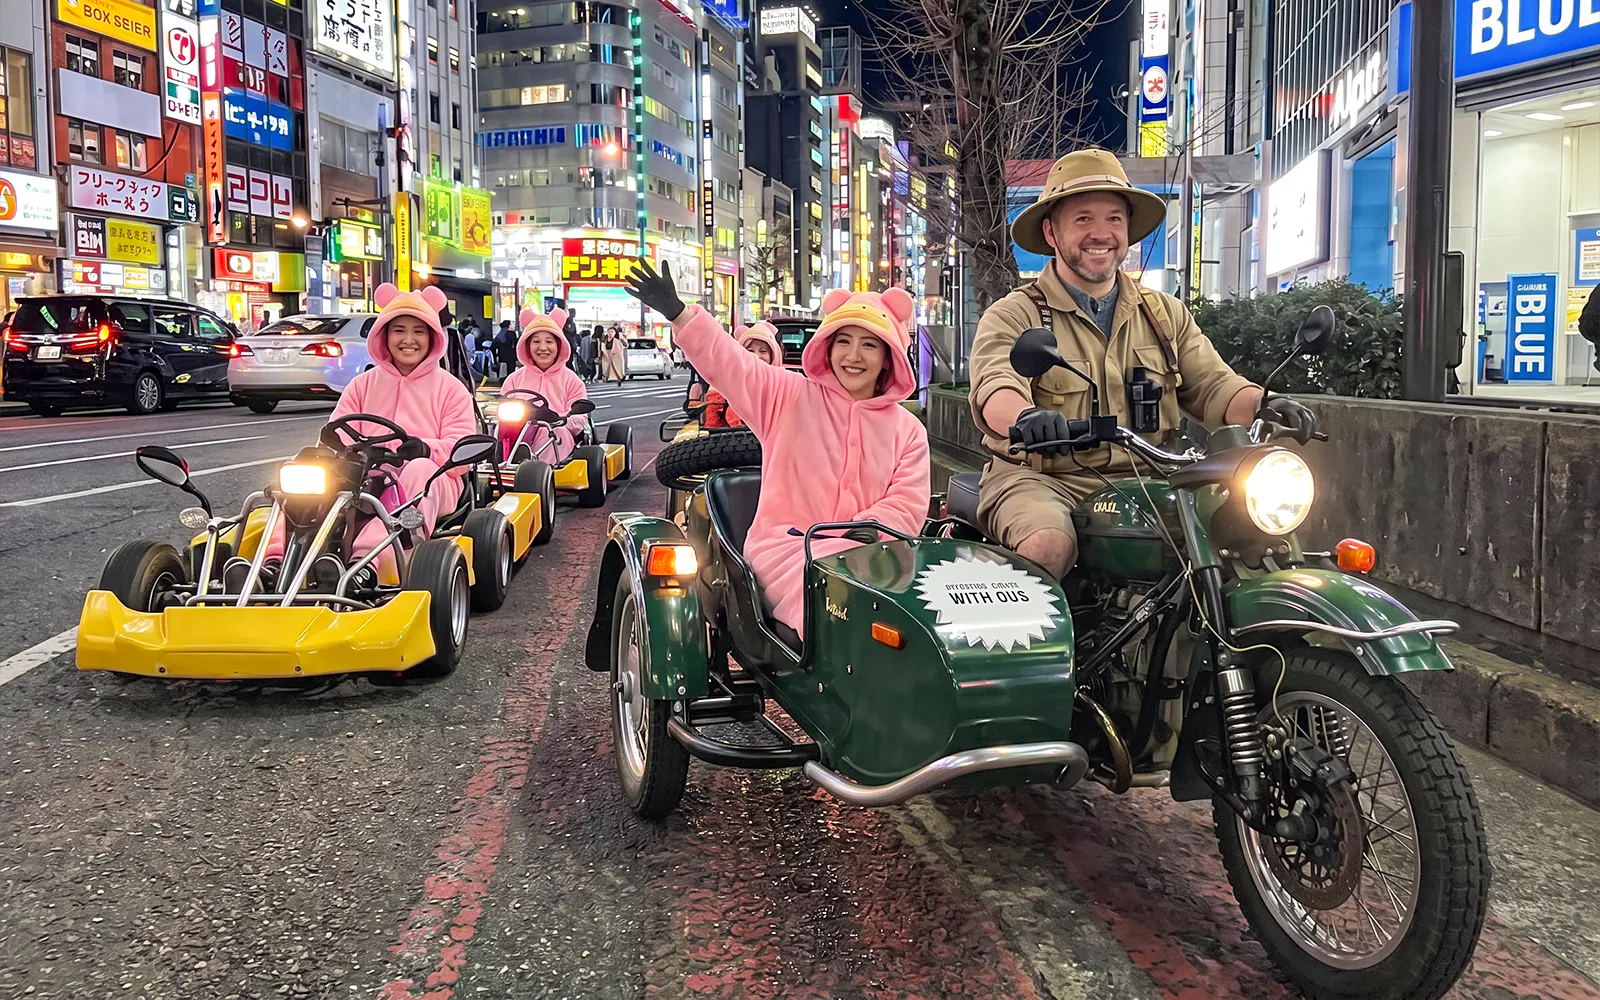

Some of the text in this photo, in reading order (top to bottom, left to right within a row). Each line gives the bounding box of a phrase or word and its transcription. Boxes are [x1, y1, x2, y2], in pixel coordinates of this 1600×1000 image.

[83, 4, 152, 38] BOX SEIER
[1514, 294, 1546, 373] BLUE
[948, 590, 1030, 605] WITH OUS
